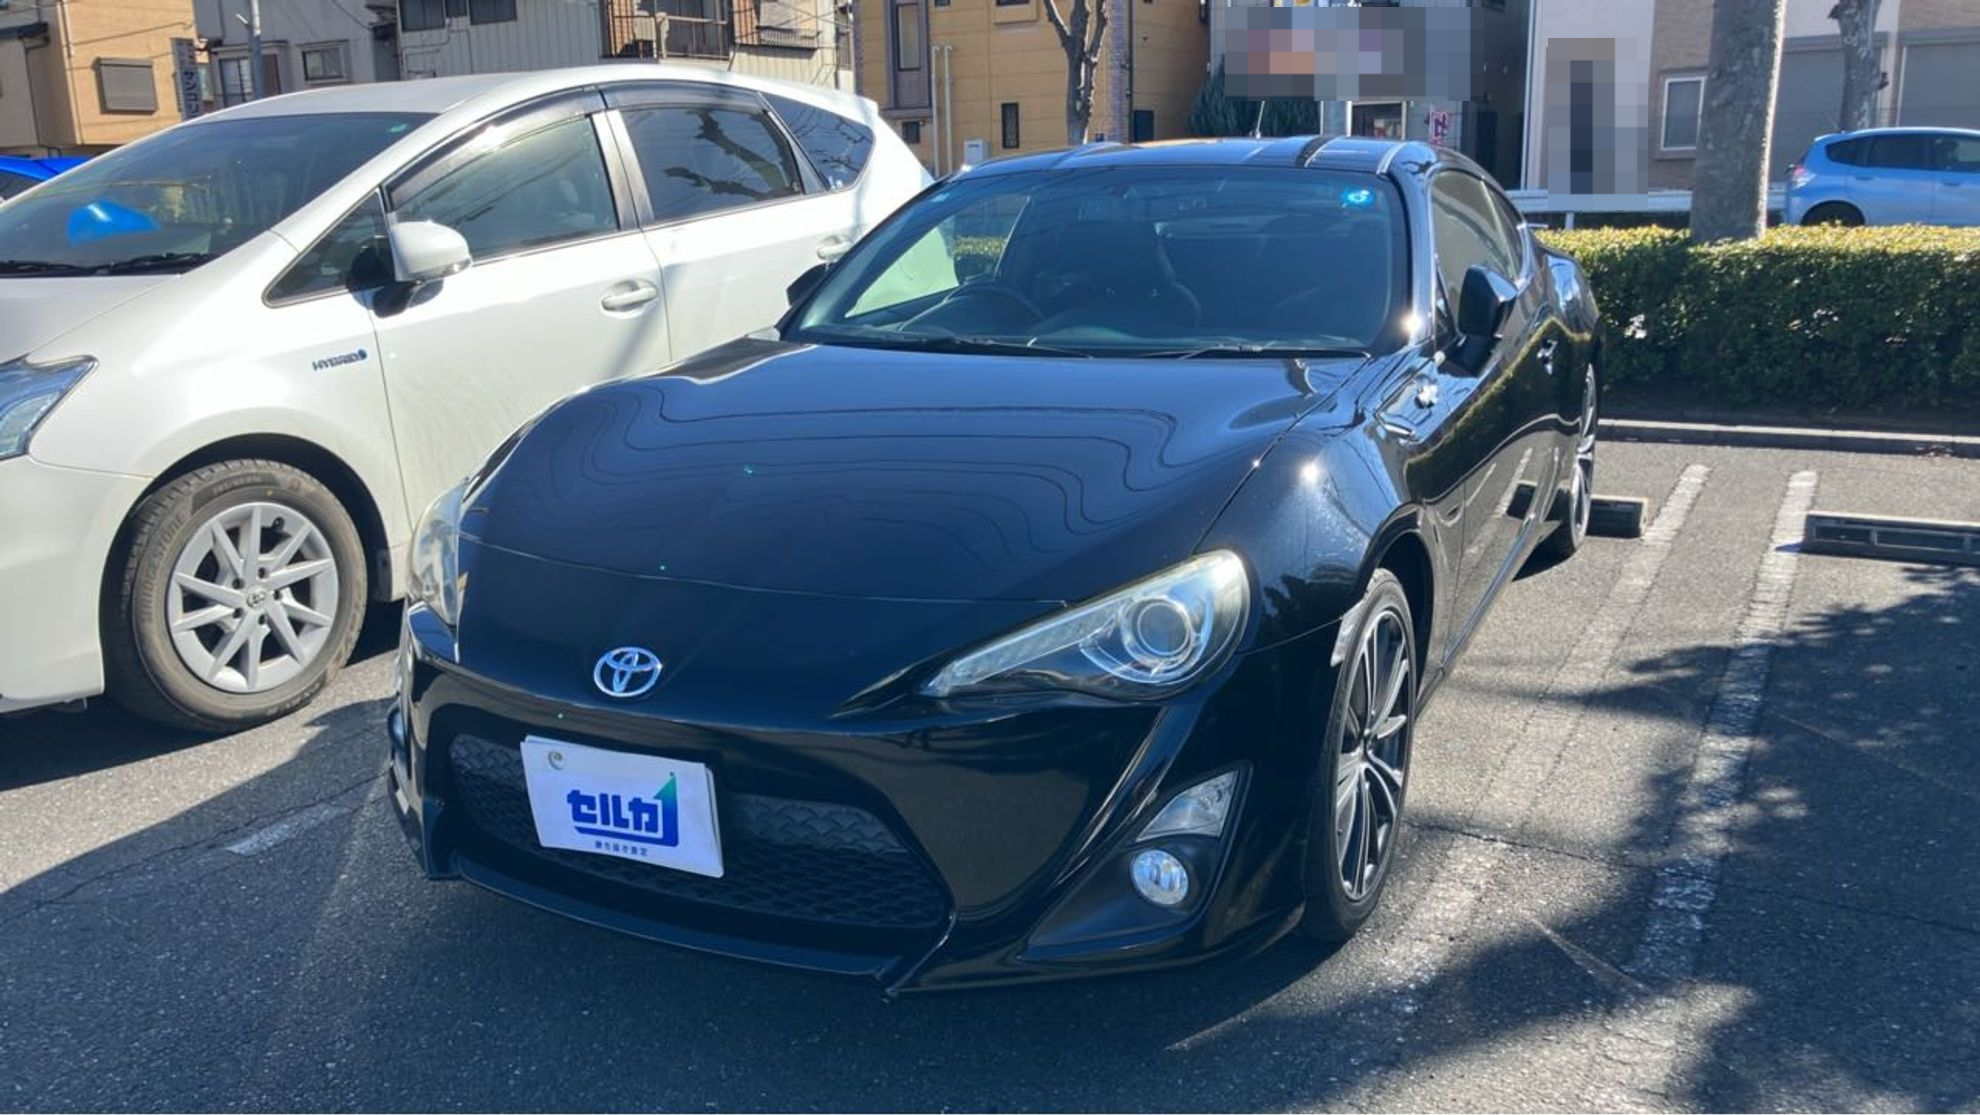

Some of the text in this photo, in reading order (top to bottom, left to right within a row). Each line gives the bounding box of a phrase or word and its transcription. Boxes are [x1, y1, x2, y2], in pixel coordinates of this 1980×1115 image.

[312, 352, 359, 371] HYBRID
[567, 790, 659, 833] セルカ
